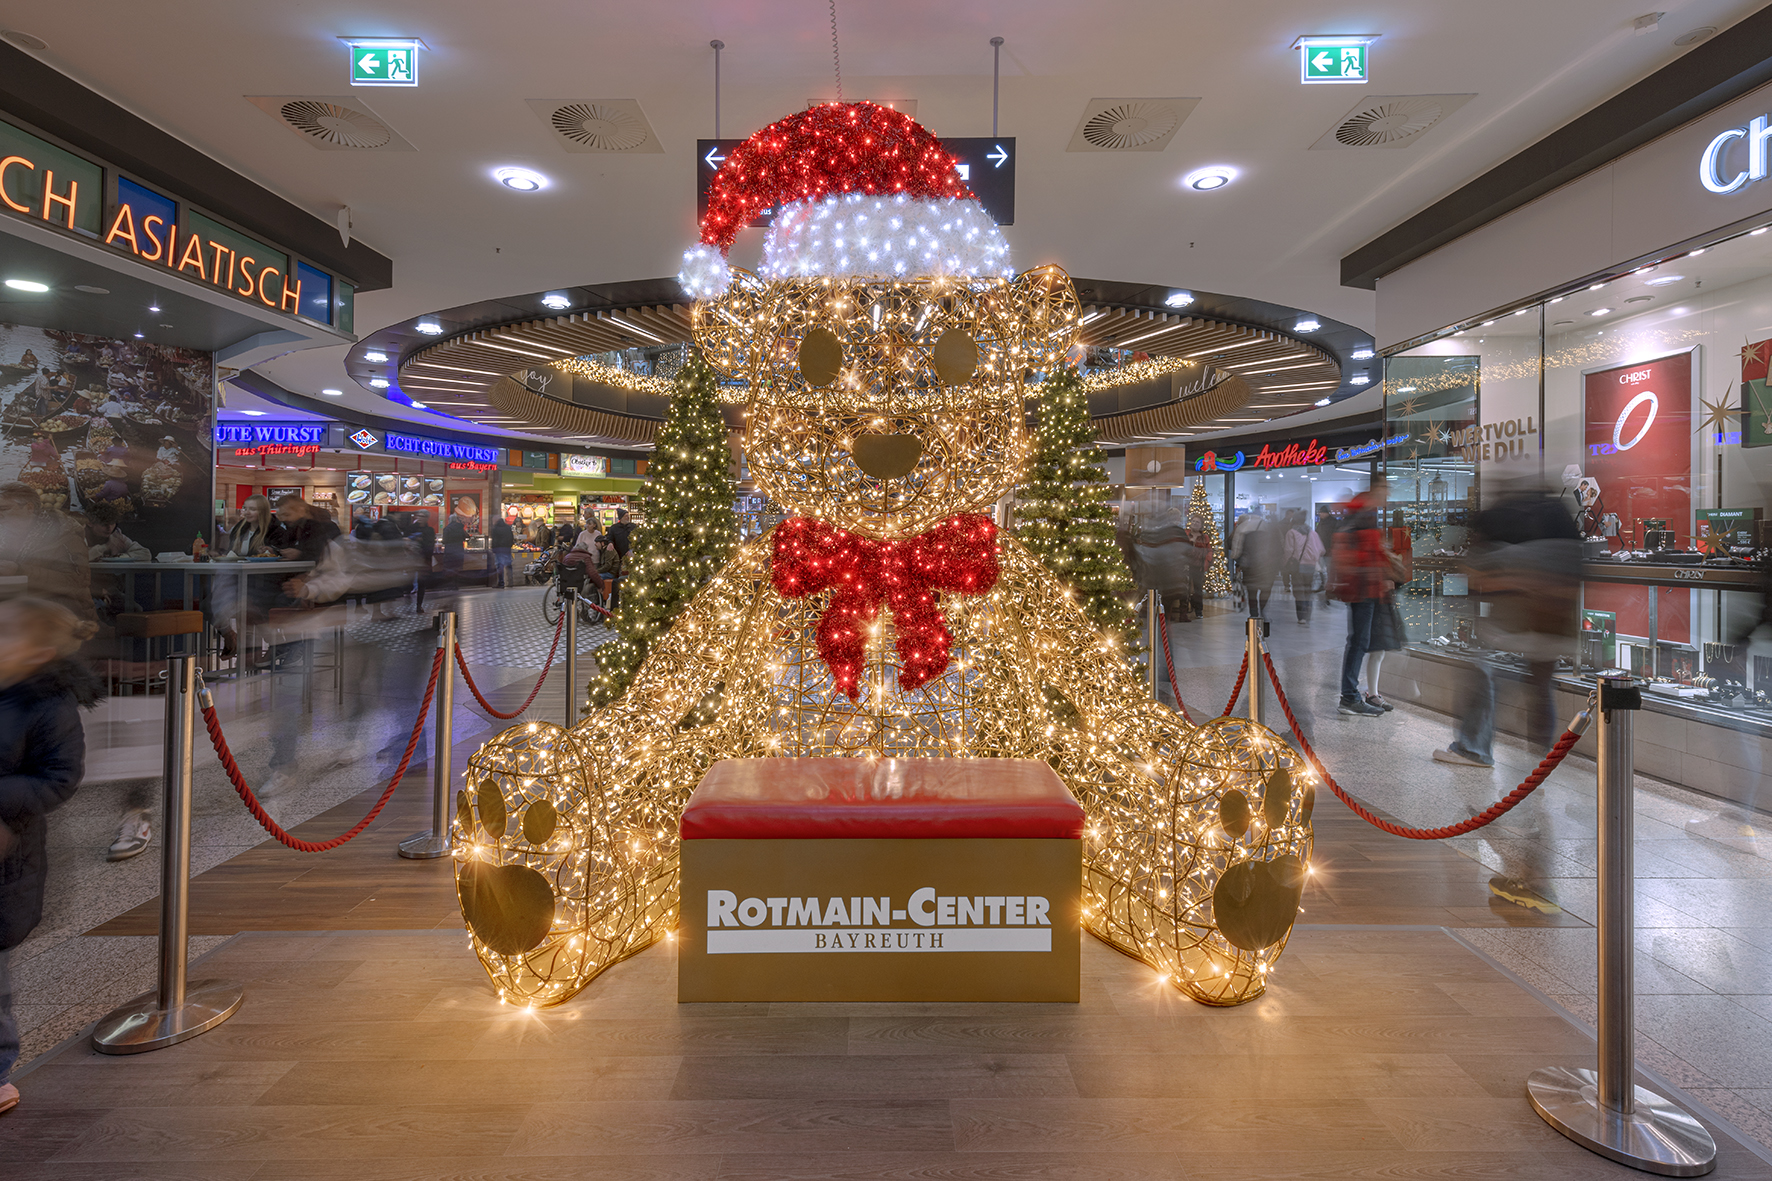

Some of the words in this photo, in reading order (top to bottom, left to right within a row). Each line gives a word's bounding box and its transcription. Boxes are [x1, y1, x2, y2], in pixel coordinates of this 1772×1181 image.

[0, 155, 77, 230] CH
[105, 203, 302, 315] ASIATISCH
[1619, 369, 1652, 384] CHRIST
[254, 426, 323, 442] WURST
[1450, 416, 1537, 447] WERTVOLL
[235, 447, 256, 456] aus
[257, 443, 320, 457] Thüringen
[386, 434, 420, 452] ECHT
[421, 440, 452, 457] GUTE
[452, 444, 499, 463] WURST
[1253, 438, 1328, 471] Apotheke
[1462, 443, 1490, 463] WIE
[1494, 438, 1531, 463] DU.
[467, 461, 498, 473] Bayern
[706, 887, 1052, 927] ROTMAIN-CENTER
[814, 932, 945, 949] BAYREUTH
